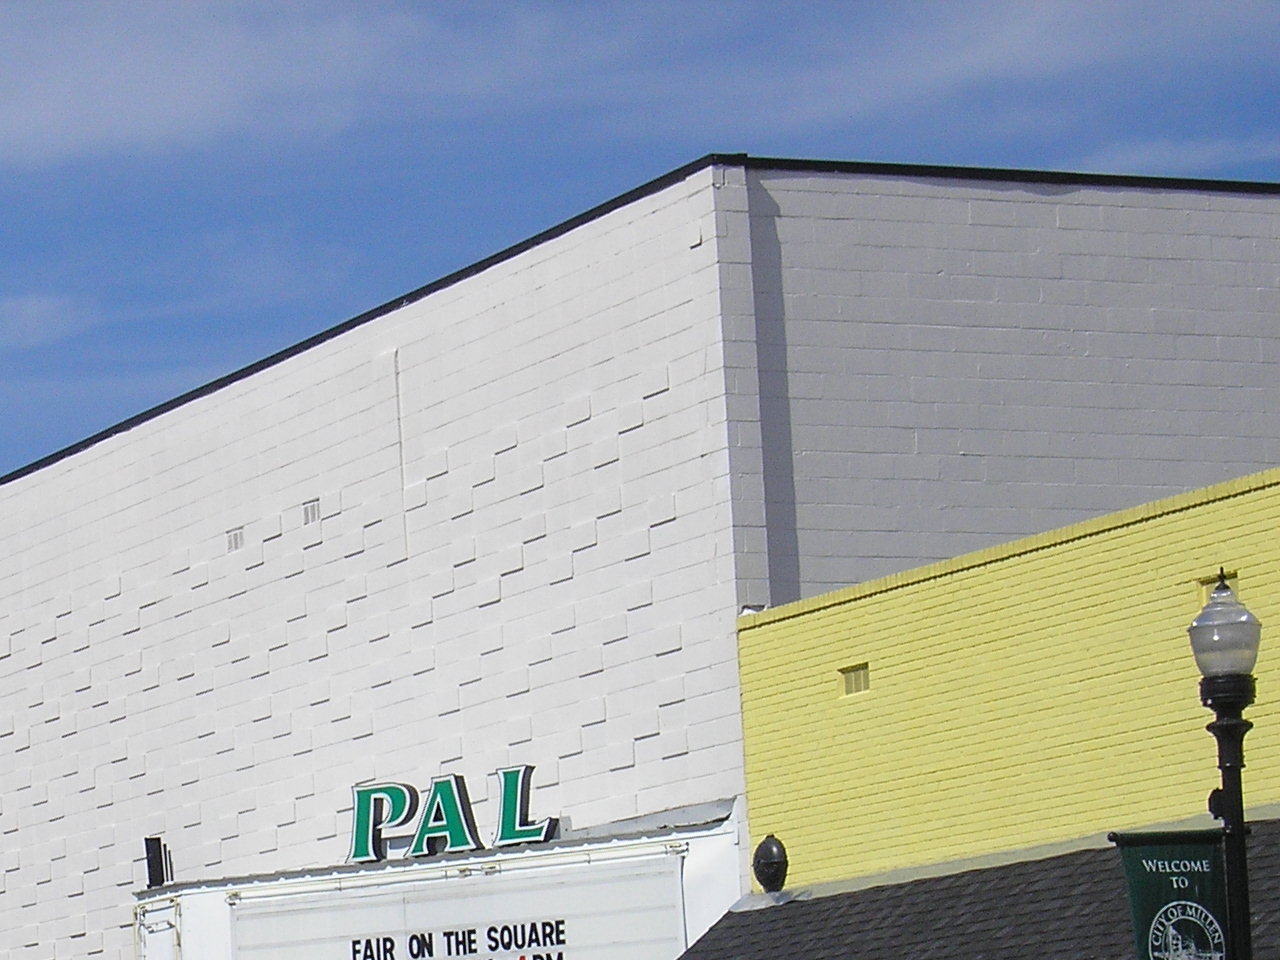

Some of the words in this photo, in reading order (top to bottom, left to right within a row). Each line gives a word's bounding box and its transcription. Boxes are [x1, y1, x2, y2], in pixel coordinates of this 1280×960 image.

[346, 765, 559, 863] PAL
[1142, 859, 1210, 873] WELCOME
[1170, 876, 1189, 889] TO
[408, 932, 434, 960] ON
[442, 928, 477, 956] THE
[486, 919, 566, 951] SQUARE
[1152, 914, 1168, 945] CITY
[1167, 905, 1184, 919] OF
[1185, 905, 1222, 944] MILLEN
